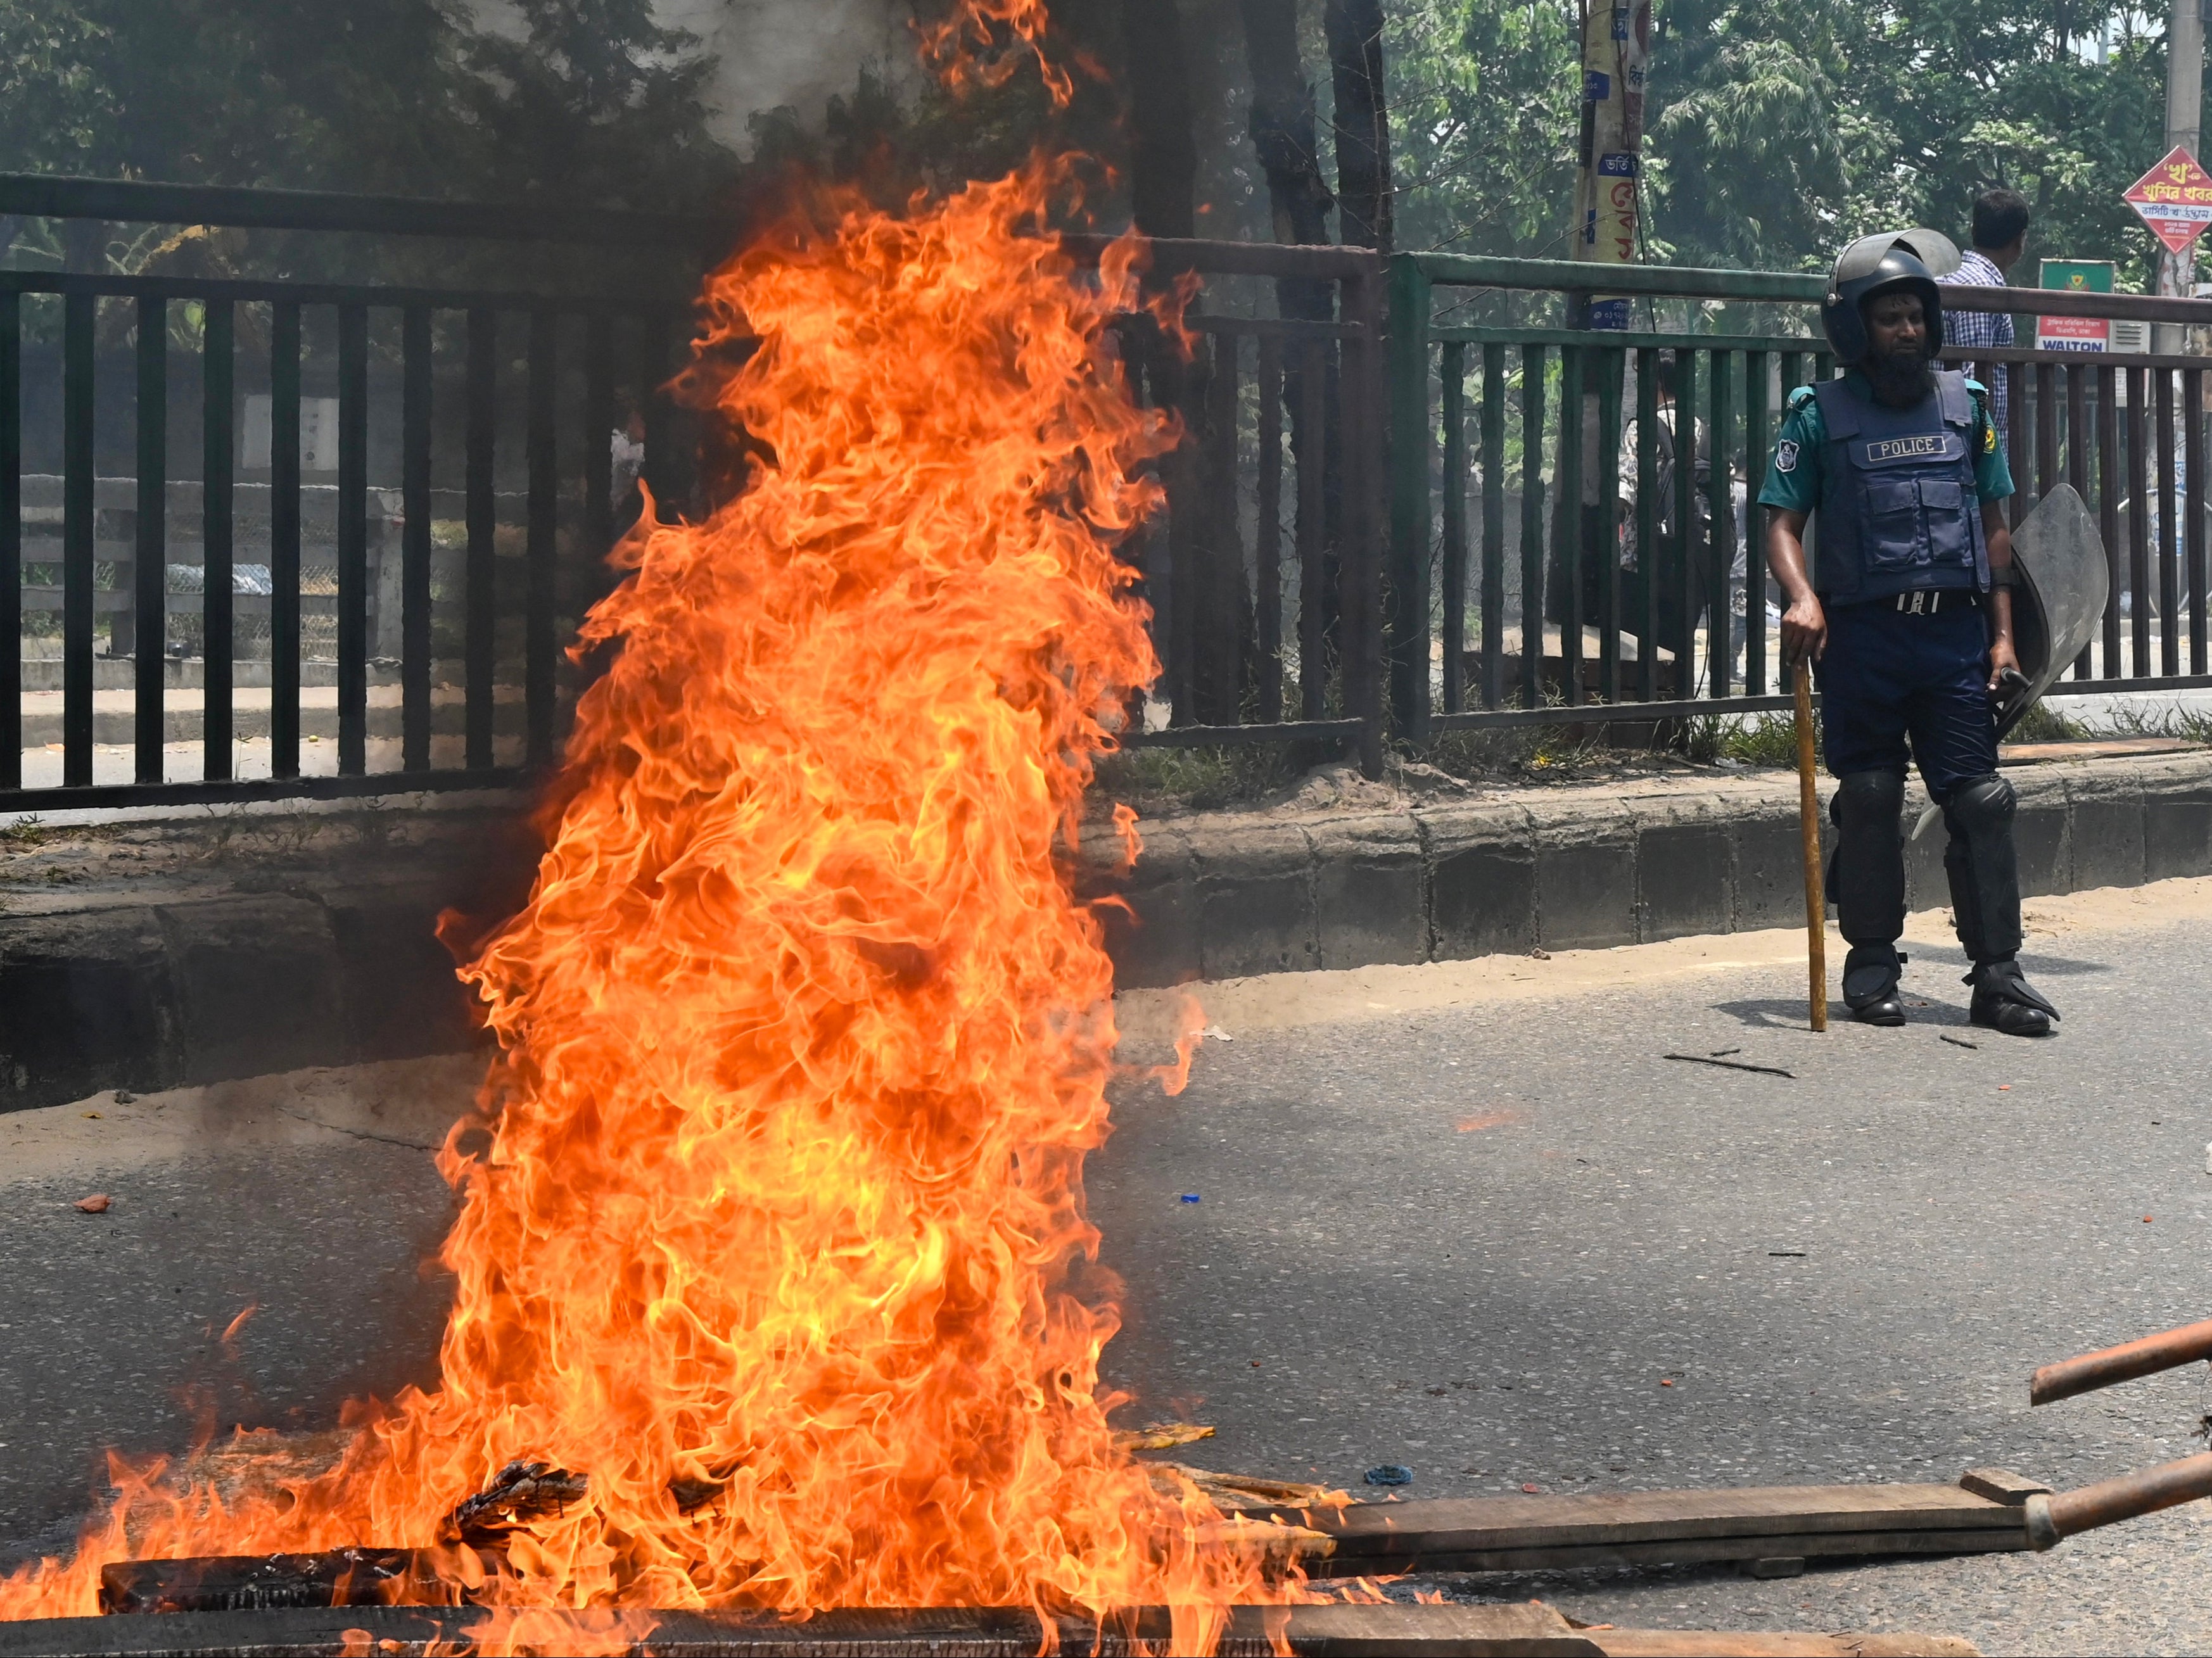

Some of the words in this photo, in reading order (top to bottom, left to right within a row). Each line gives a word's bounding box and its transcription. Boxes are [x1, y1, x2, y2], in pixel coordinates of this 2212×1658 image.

[1605, 156, 1629, 171] ভর্তি
[2142, 182, 2181, 202] খুশির
[2184, 186, 2212, 202] খবর
[2043, 340, 2102, 351] WALTON
[1881, 438, 1935, 457] POLICE
